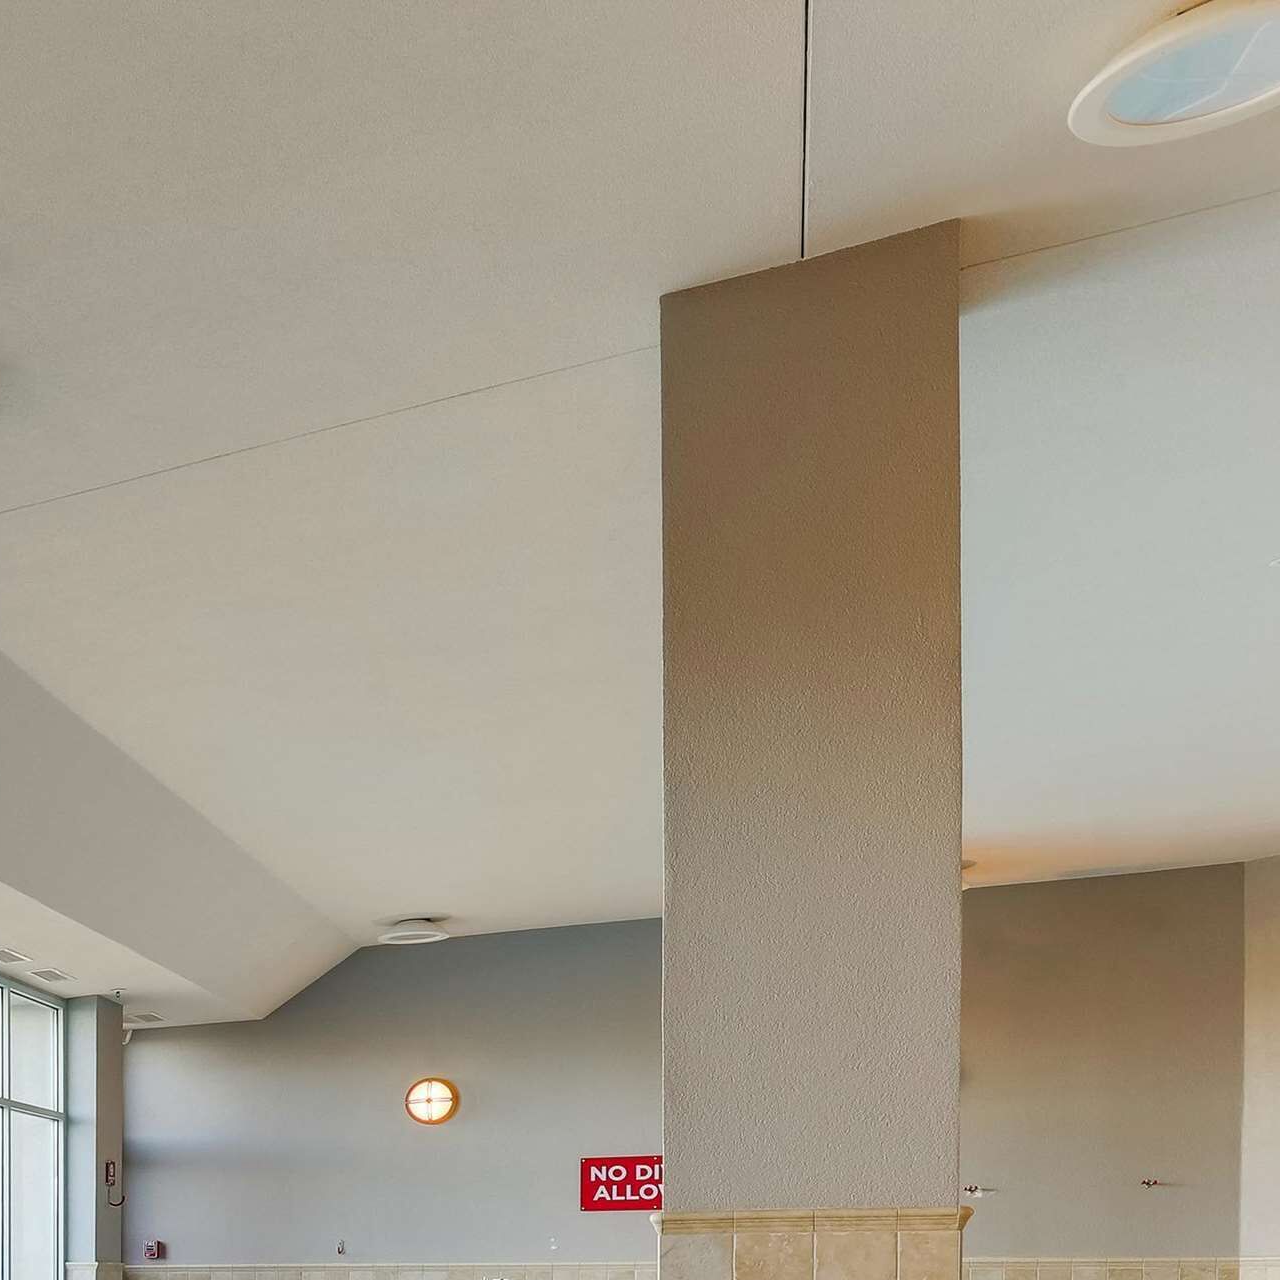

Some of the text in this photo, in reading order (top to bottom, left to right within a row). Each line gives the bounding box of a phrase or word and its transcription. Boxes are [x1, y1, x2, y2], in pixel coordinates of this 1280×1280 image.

[590, 1164, 664, 1181] NO DI
[593, 1183, 664, 1201] ALLO
